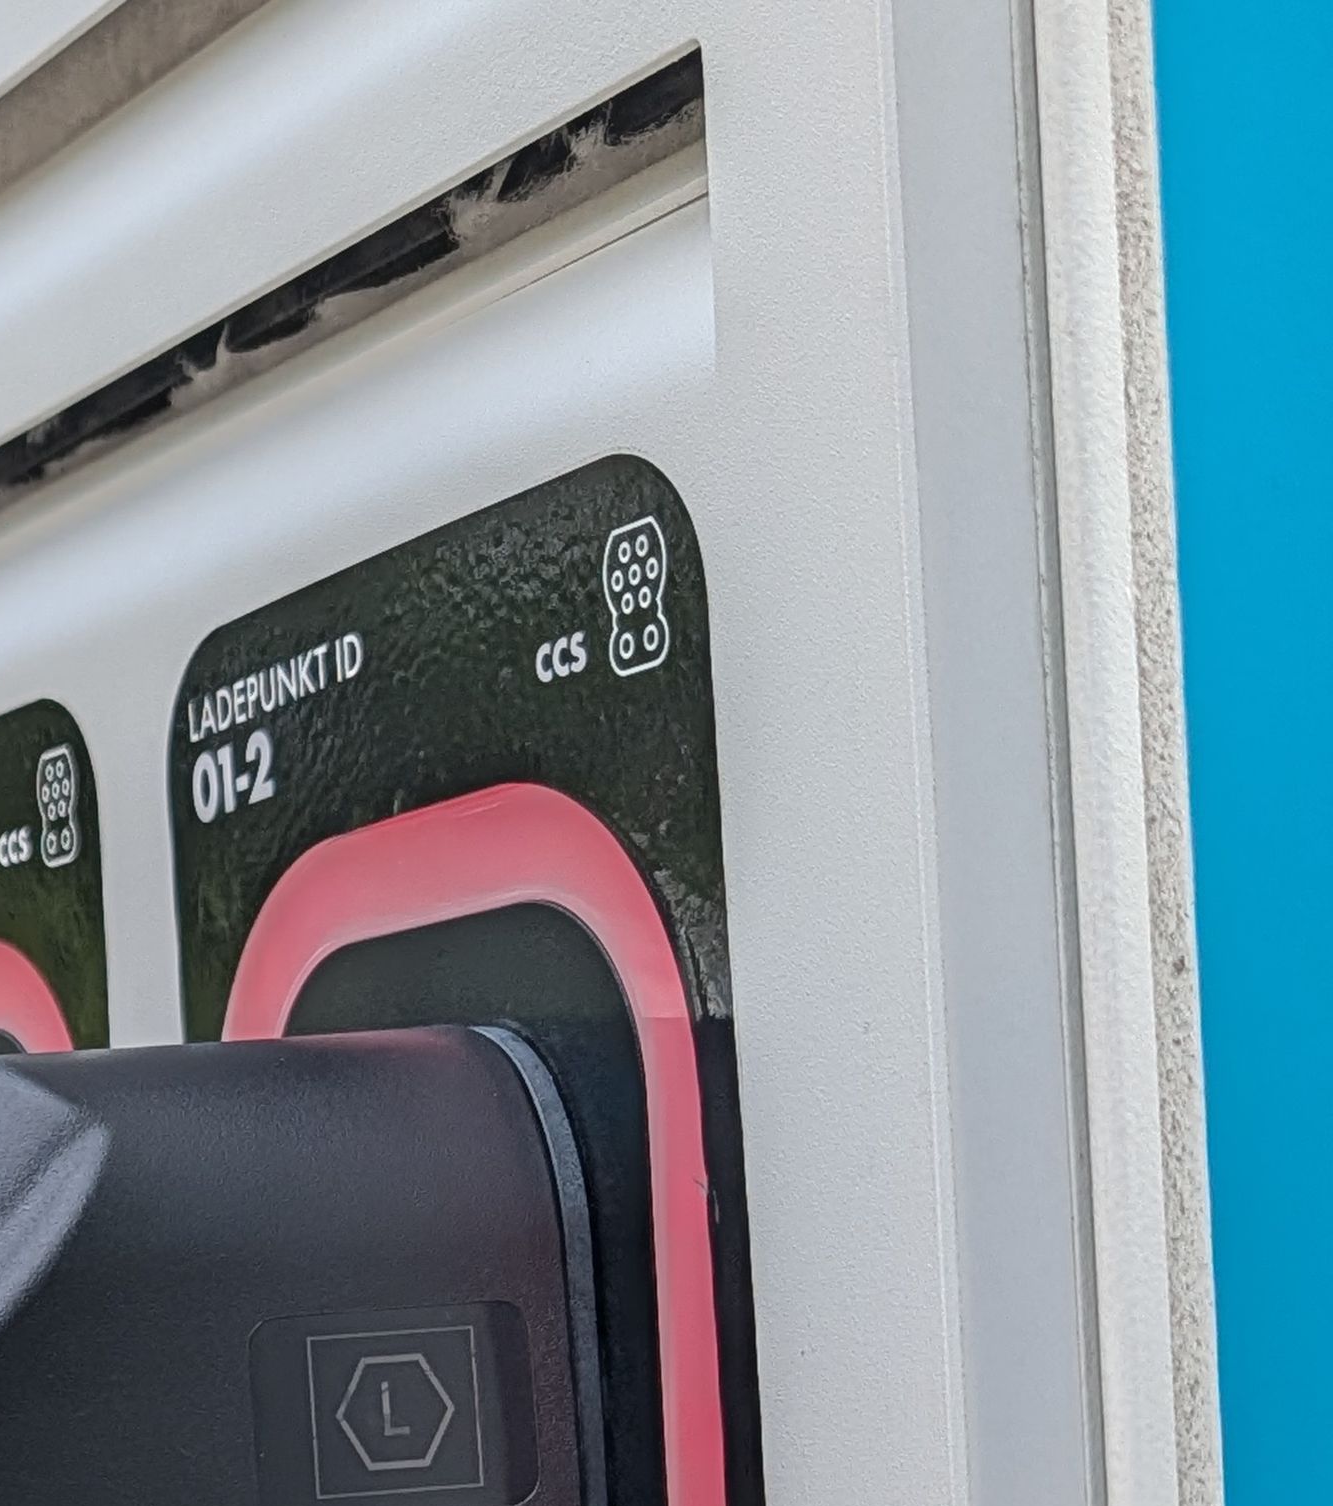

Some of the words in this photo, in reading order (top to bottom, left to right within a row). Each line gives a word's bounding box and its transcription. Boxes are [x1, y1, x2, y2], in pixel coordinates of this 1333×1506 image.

[189, 641, 330, 741] LADEPUNKT
[336, 634, 362, 682] ID
[536, 631, 587, 682] CCS
[193, 729, 275, 822] 01-2
[381, 1380, 411, 1436] L
